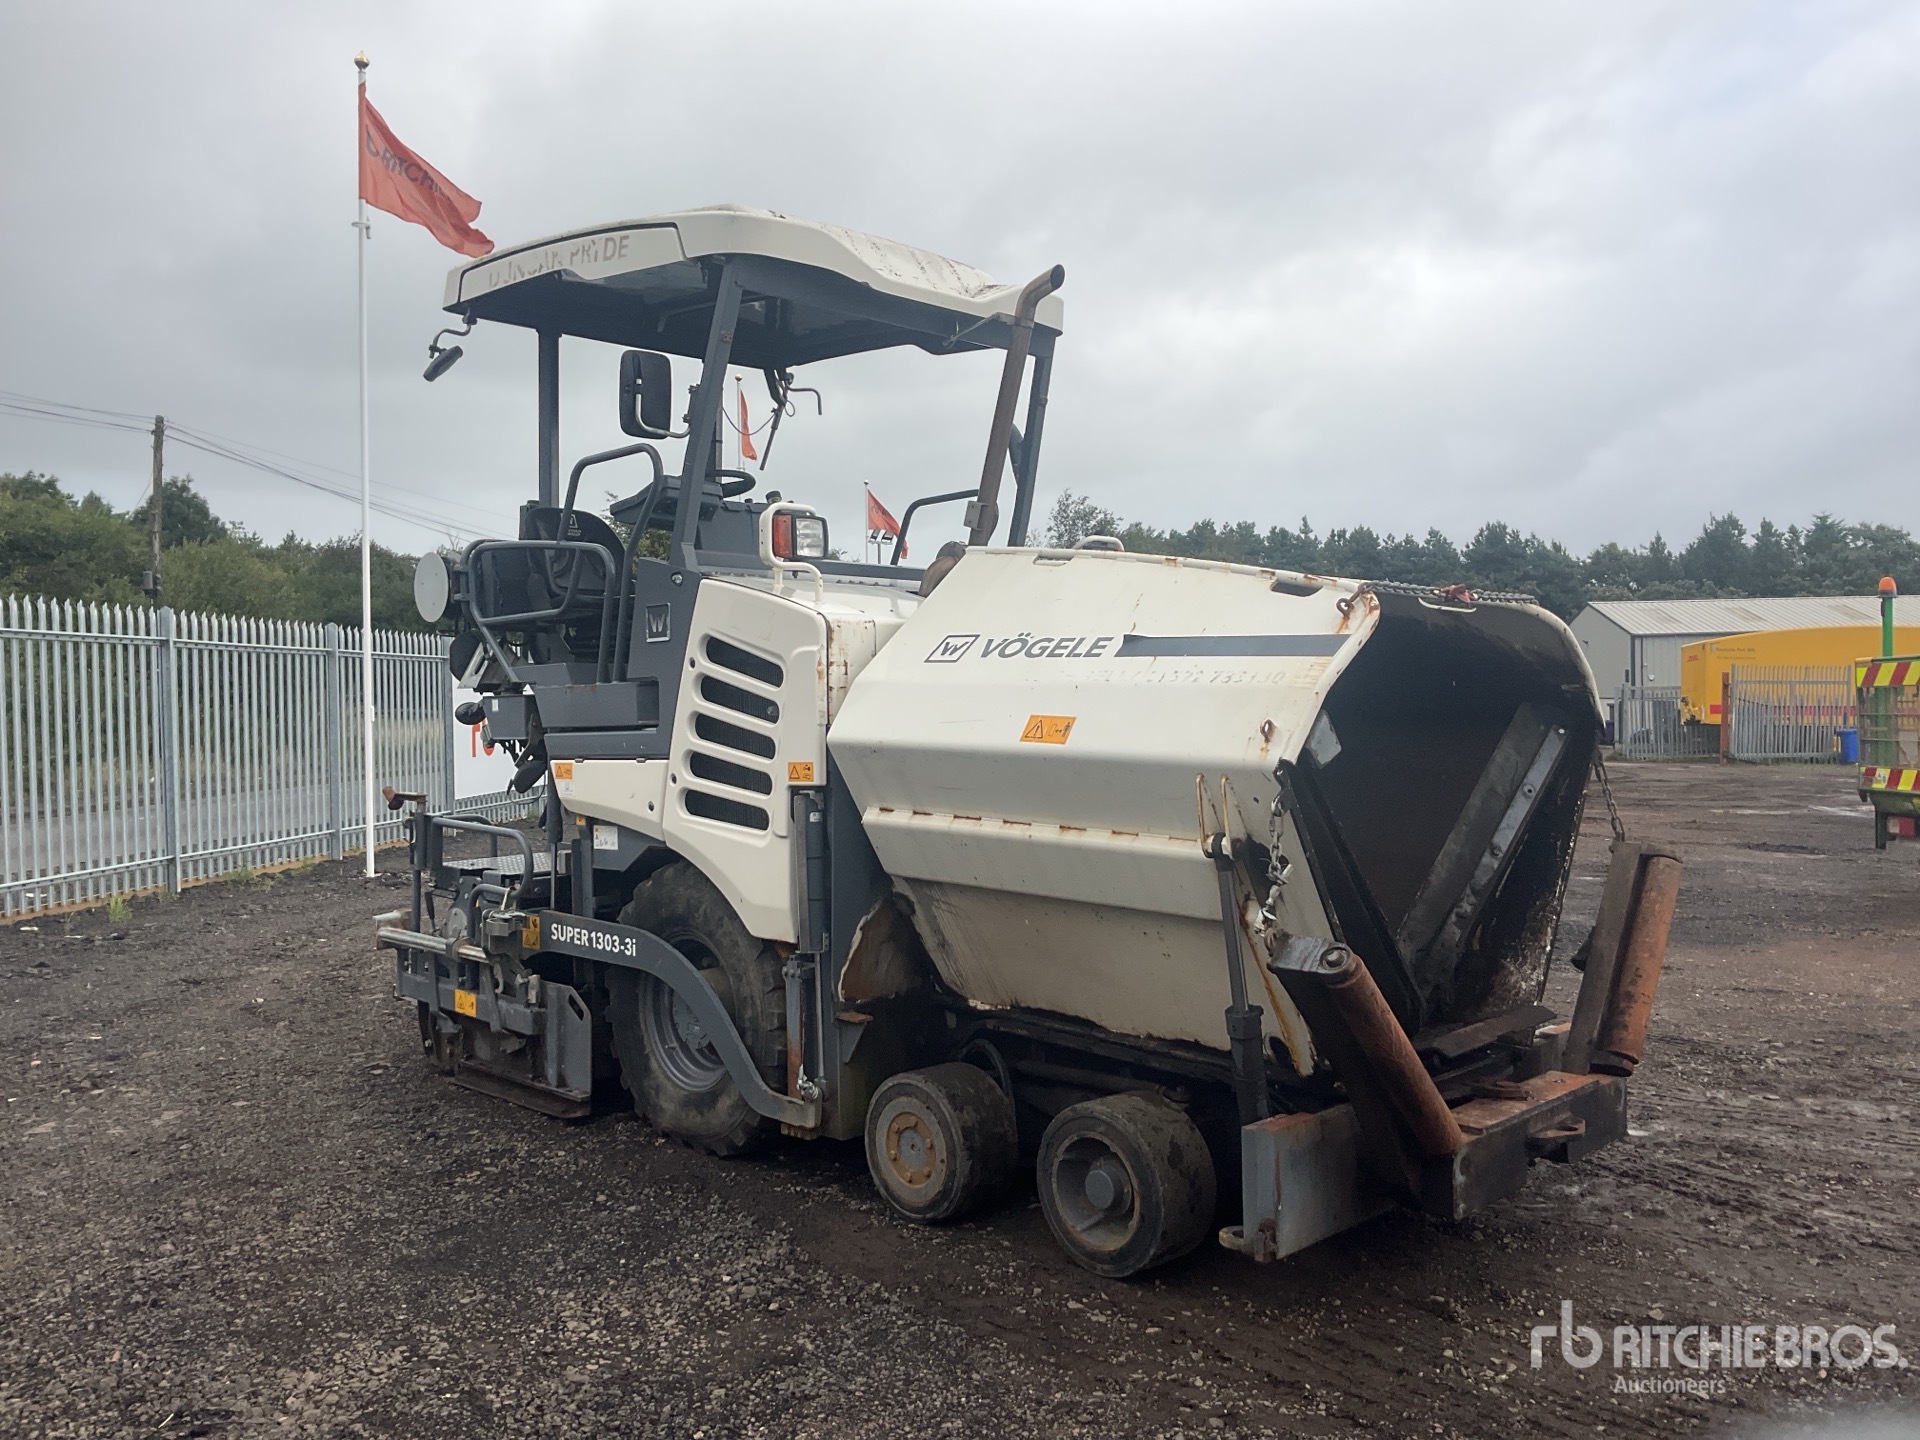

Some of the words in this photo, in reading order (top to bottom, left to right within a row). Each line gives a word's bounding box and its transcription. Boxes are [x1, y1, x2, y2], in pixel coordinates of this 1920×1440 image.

[570, 234, 630, 266] PRIDE
[980, 632, 1115, 658] VÖGELE
[551, 923, 589, 947] SUPER
[590, 931, 636, 957] 1303-3i
